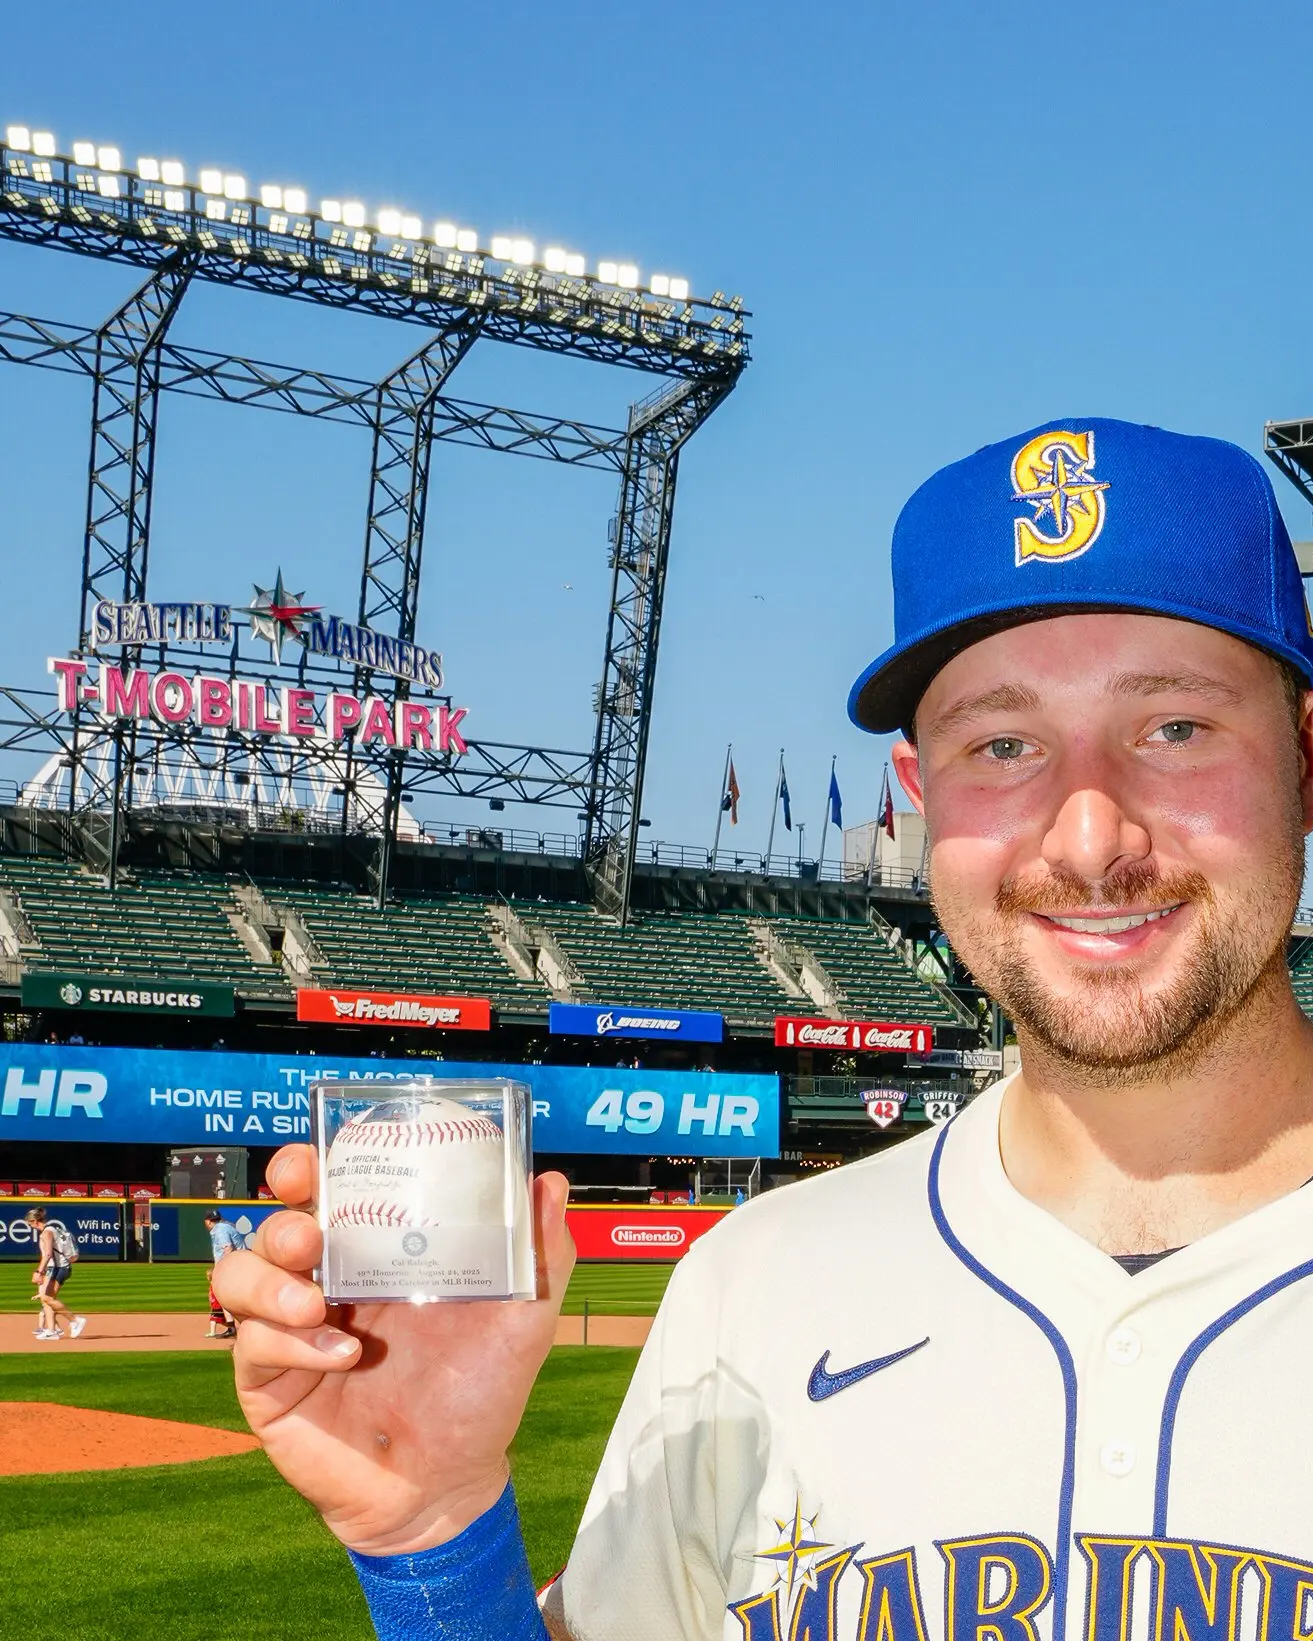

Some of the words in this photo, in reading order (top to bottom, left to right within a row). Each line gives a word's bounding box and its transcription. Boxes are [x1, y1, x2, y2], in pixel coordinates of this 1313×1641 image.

[92, 600, 233, 647] SEATTLE
[309, 612, 445, 690] MARINERS
[47, 657, 316, 738] T-MOBILE
[327, 692, 470, 755] PARK
[89, 988, 202, 1008] STARBUCKS
[616, 1016, 681, 1030] BOEING
[798, 1023, 848, 1045] Coca-Cola
[865, 1028, 912, 1049] Coca-Cola
[1, 1067, 108, 1118] HR
[150, 1087, 243, 1109] HOME
[252, 1091, 310, 1111] RUN
[864, 1090, 904, 1101] ROBINSON
[923, 1092, 958, 1101] GRIFFEY
[586, 1089, 663, 1134] 49
[676, 1094, 760, 1137] HR
[874, 1101, 894, 1118] 42
[932, 1103, 950, 1119] 24
[205, 1113, 234, 1132] IN
[242, 1115, 265, 1133] A
[352, 1155, 380, 1163] OFFICIAL
[783, 1151, 802, 1161] BAR
[347, 1165, 372, 1176] LEAGUE
[374, 1166, 419, 1177] BASEBALL
[78, 1219, 99, 1230] Wifi
[101, 1219, 113, 1230] in
[78, 1233, 90, 1243] of
[91, 1233, 103, 1243] its
[617, 1230, 679, 1242] Nintendo
[391, 1259, 405, 1267] Cal
[362, 1279, 379, 1287] HRs
[380, 1280, 390, 1288] by
[442, 1278, 462, 1286] MLB
[463, 1277, 493, 1286] History
